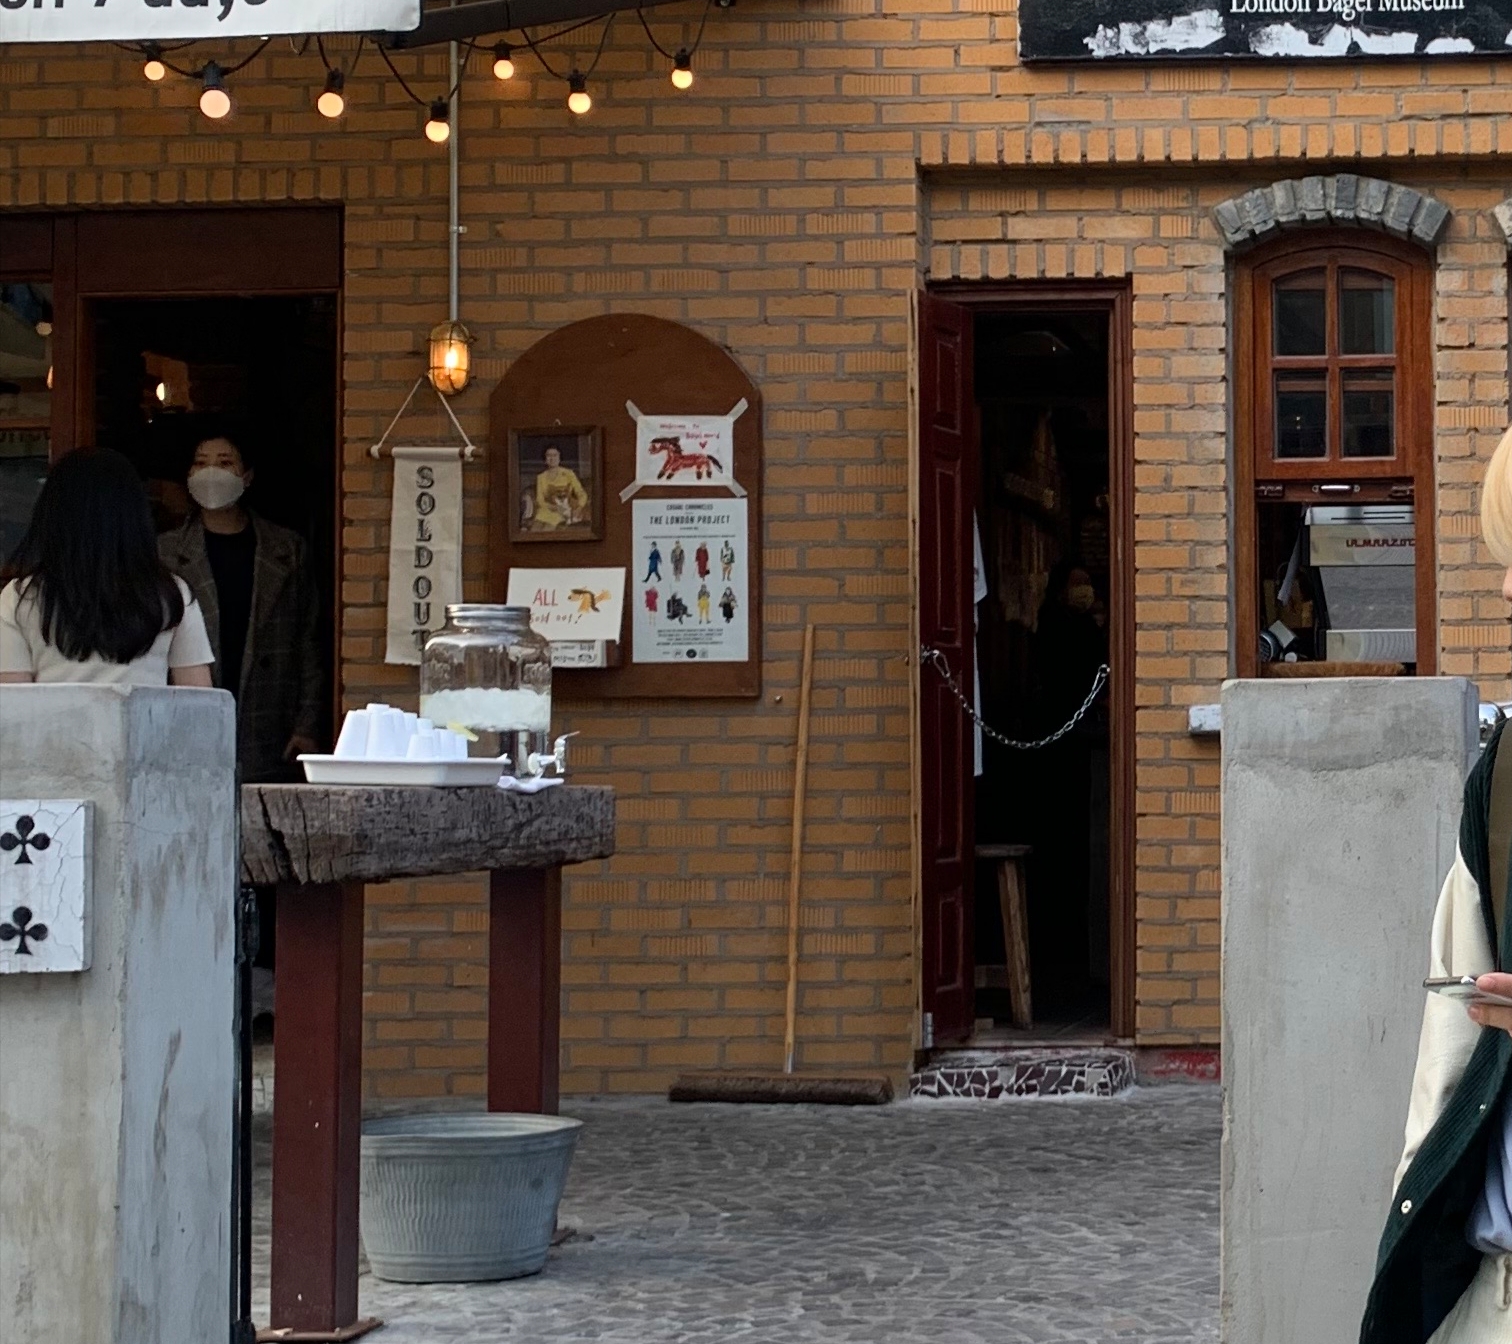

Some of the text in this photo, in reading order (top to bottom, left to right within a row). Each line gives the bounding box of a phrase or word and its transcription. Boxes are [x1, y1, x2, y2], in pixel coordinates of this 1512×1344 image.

[650, 515, 731, 525] THE LONDON PROJECT
[533, 588, 559, 606] ALL
